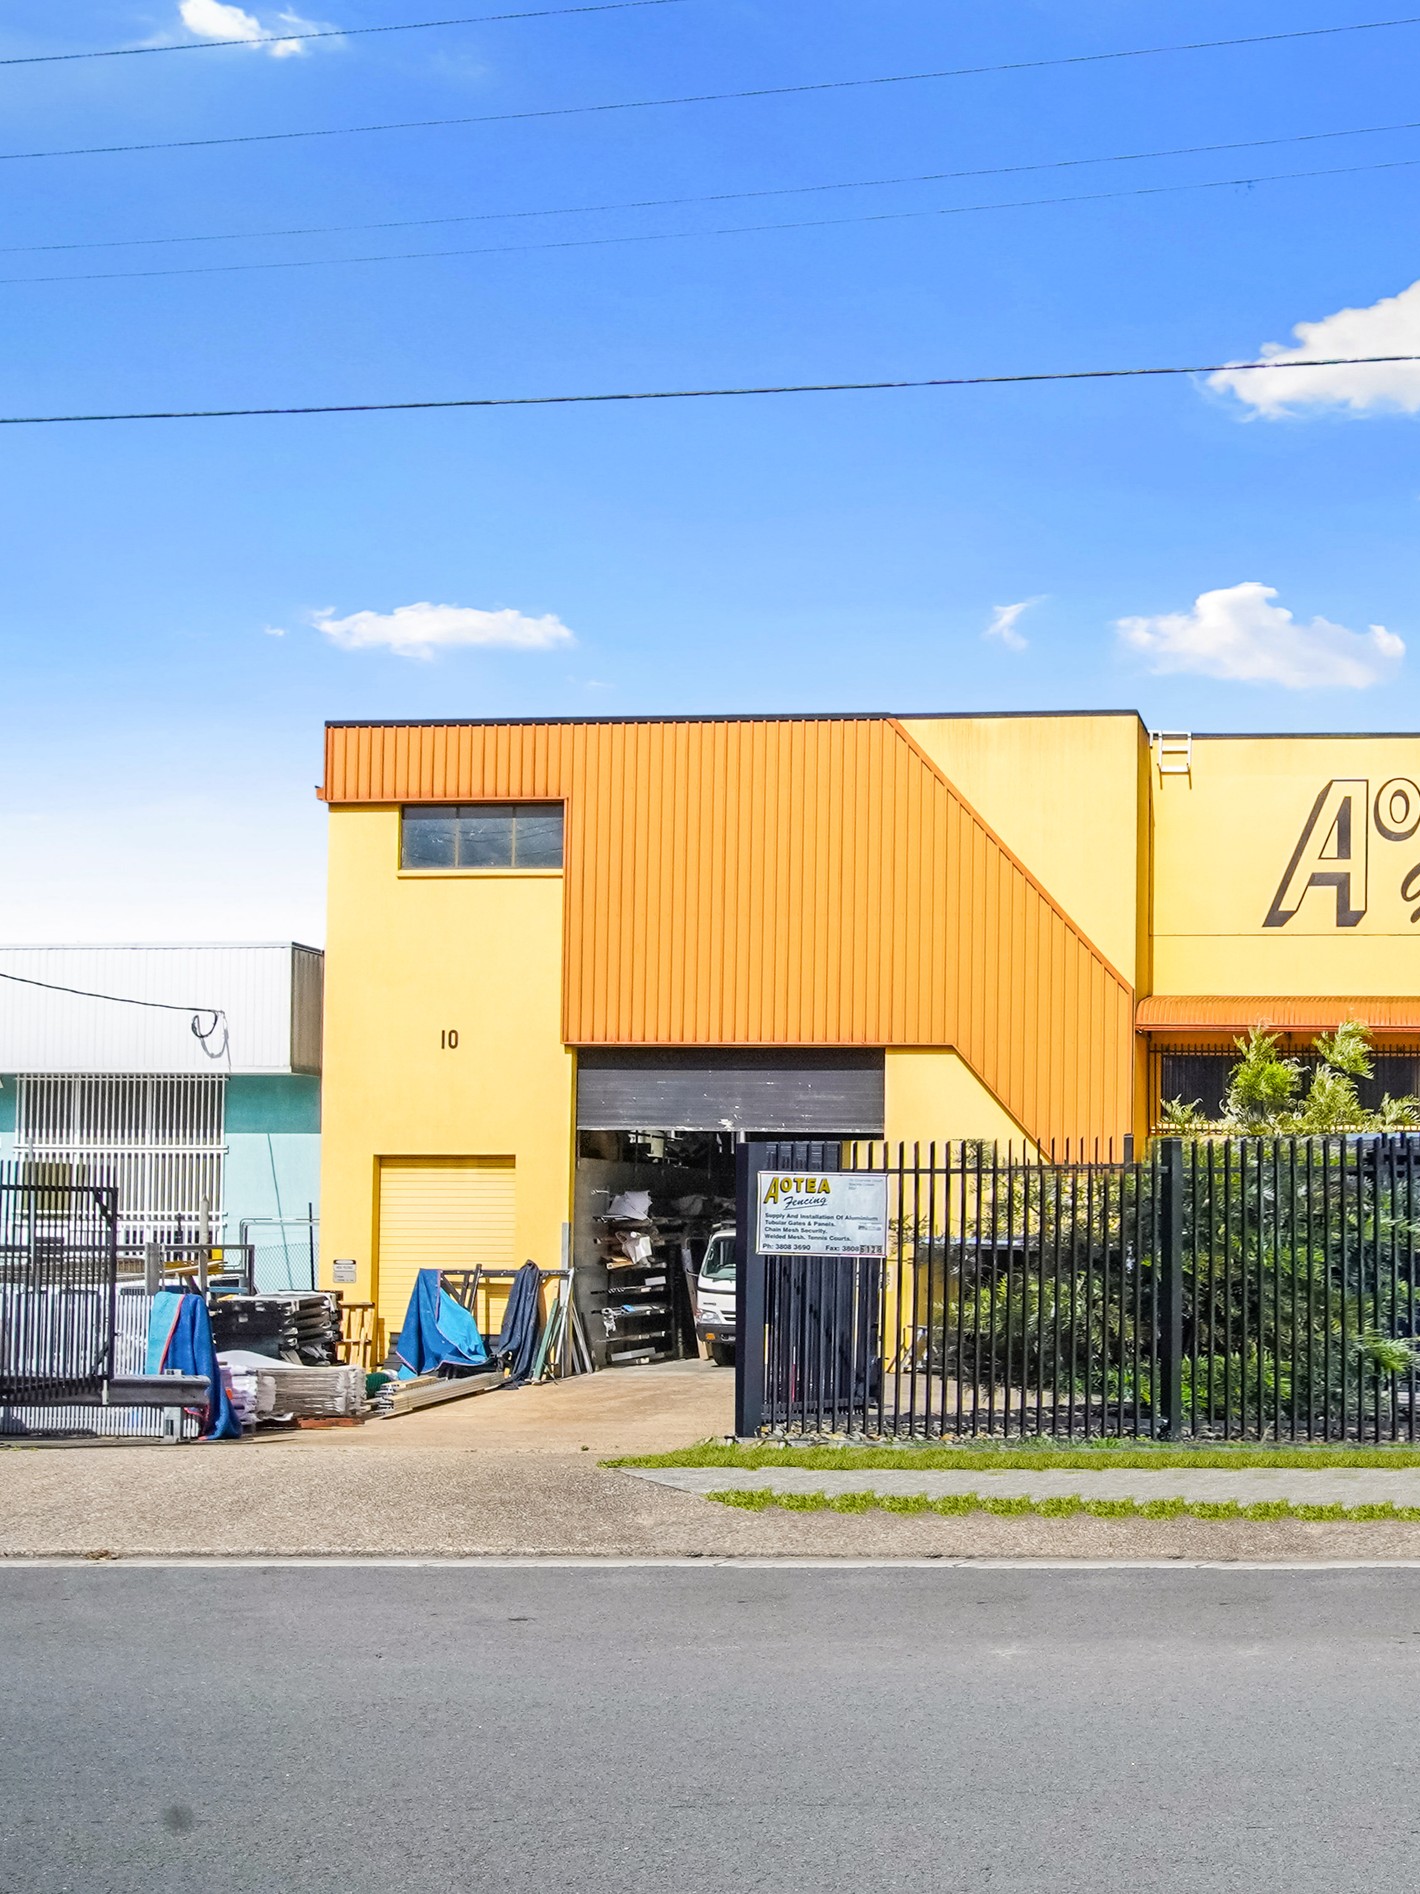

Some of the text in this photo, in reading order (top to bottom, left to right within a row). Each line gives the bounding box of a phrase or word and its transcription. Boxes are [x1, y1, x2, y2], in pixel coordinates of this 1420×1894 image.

[441, 1029, 459, 1050] 10
[763, 1177, 831, 1205] AOTEA
[783, 1195, 828, 1209] Fencing
[765, 1212, 785, 1220] Supply
